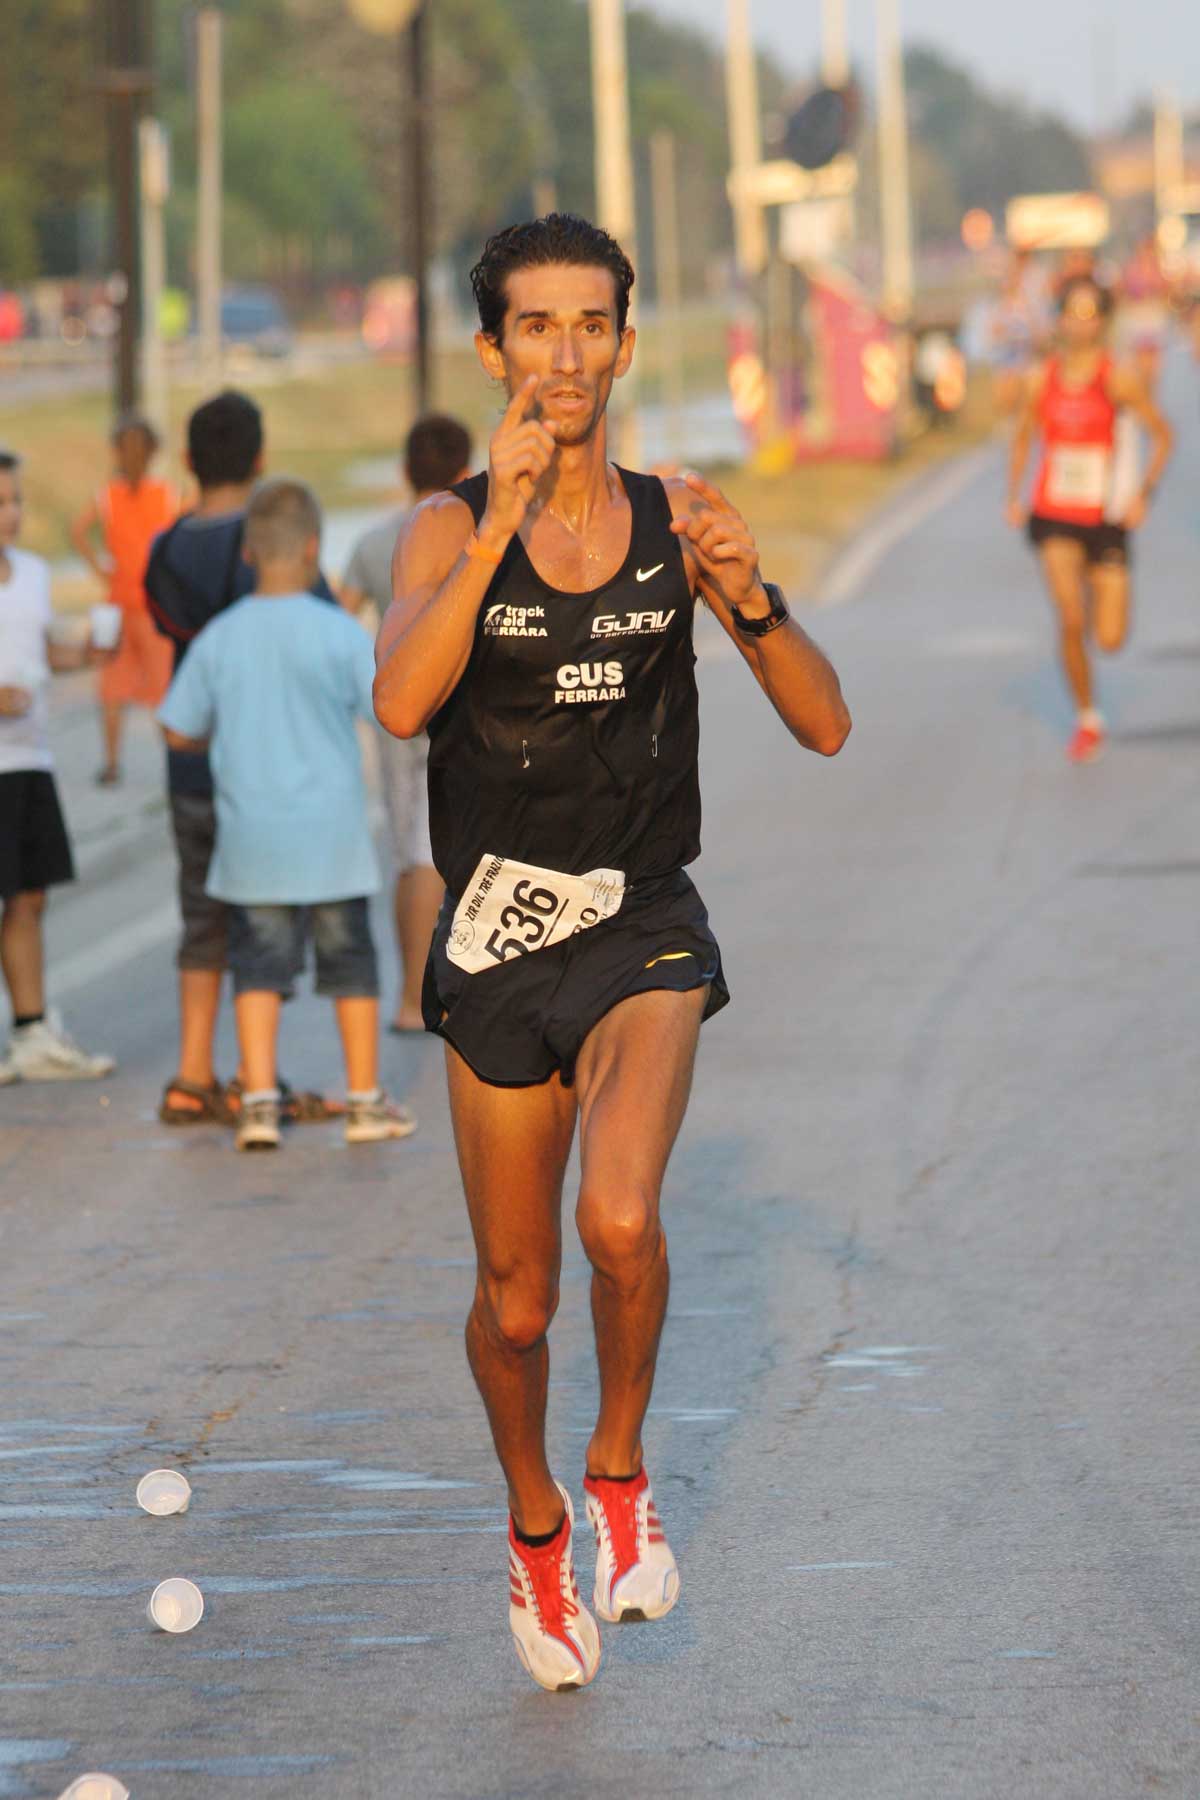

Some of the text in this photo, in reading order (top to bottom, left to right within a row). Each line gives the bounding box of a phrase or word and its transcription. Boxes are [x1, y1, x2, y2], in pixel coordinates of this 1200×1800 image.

[505, 604, 545, 617] track
[484, 626, 548, 637] FERRARA
[556, 661, 624, 689] CUS
[554, 686, 626, 704] FERRARA
[479, 877, 493, 894] TRE
[484, 879, 559, 962] 536
